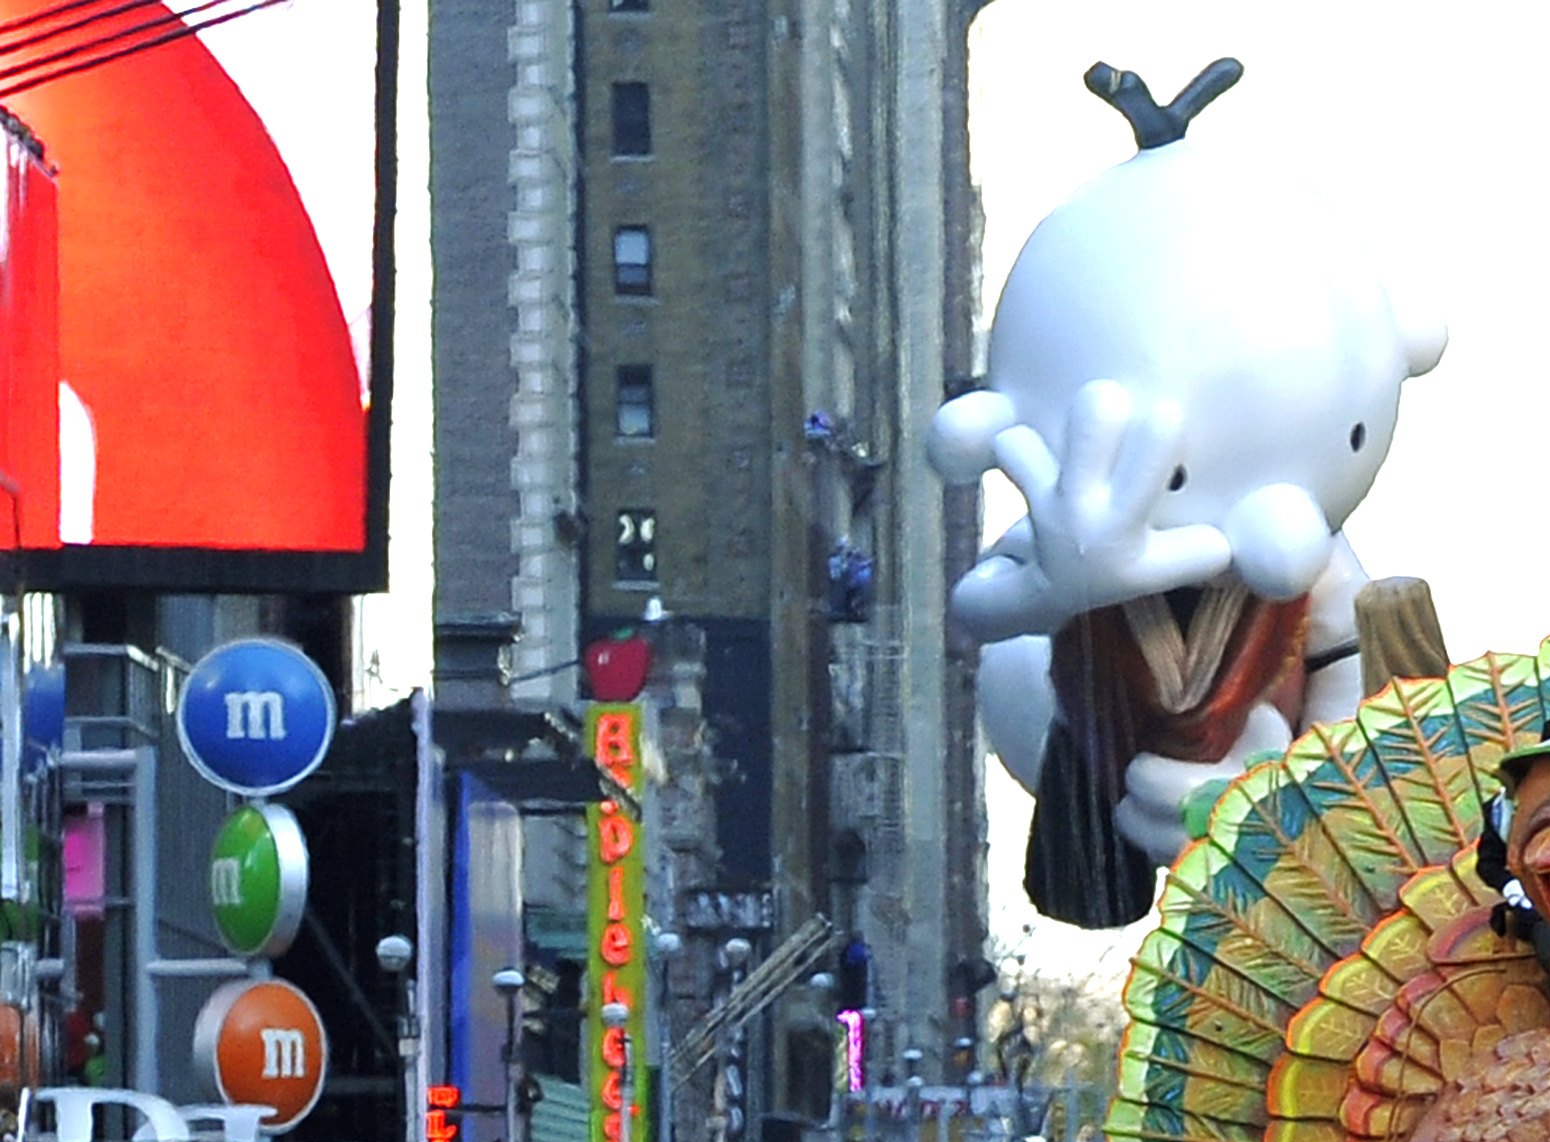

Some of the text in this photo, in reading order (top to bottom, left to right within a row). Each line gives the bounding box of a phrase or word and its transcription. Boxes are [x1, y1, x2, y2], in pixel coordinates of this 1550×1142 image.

[224, 691, 287, 740] m
[212, 857, 243, 906] m
[260, 1026, 306, 1080] m
